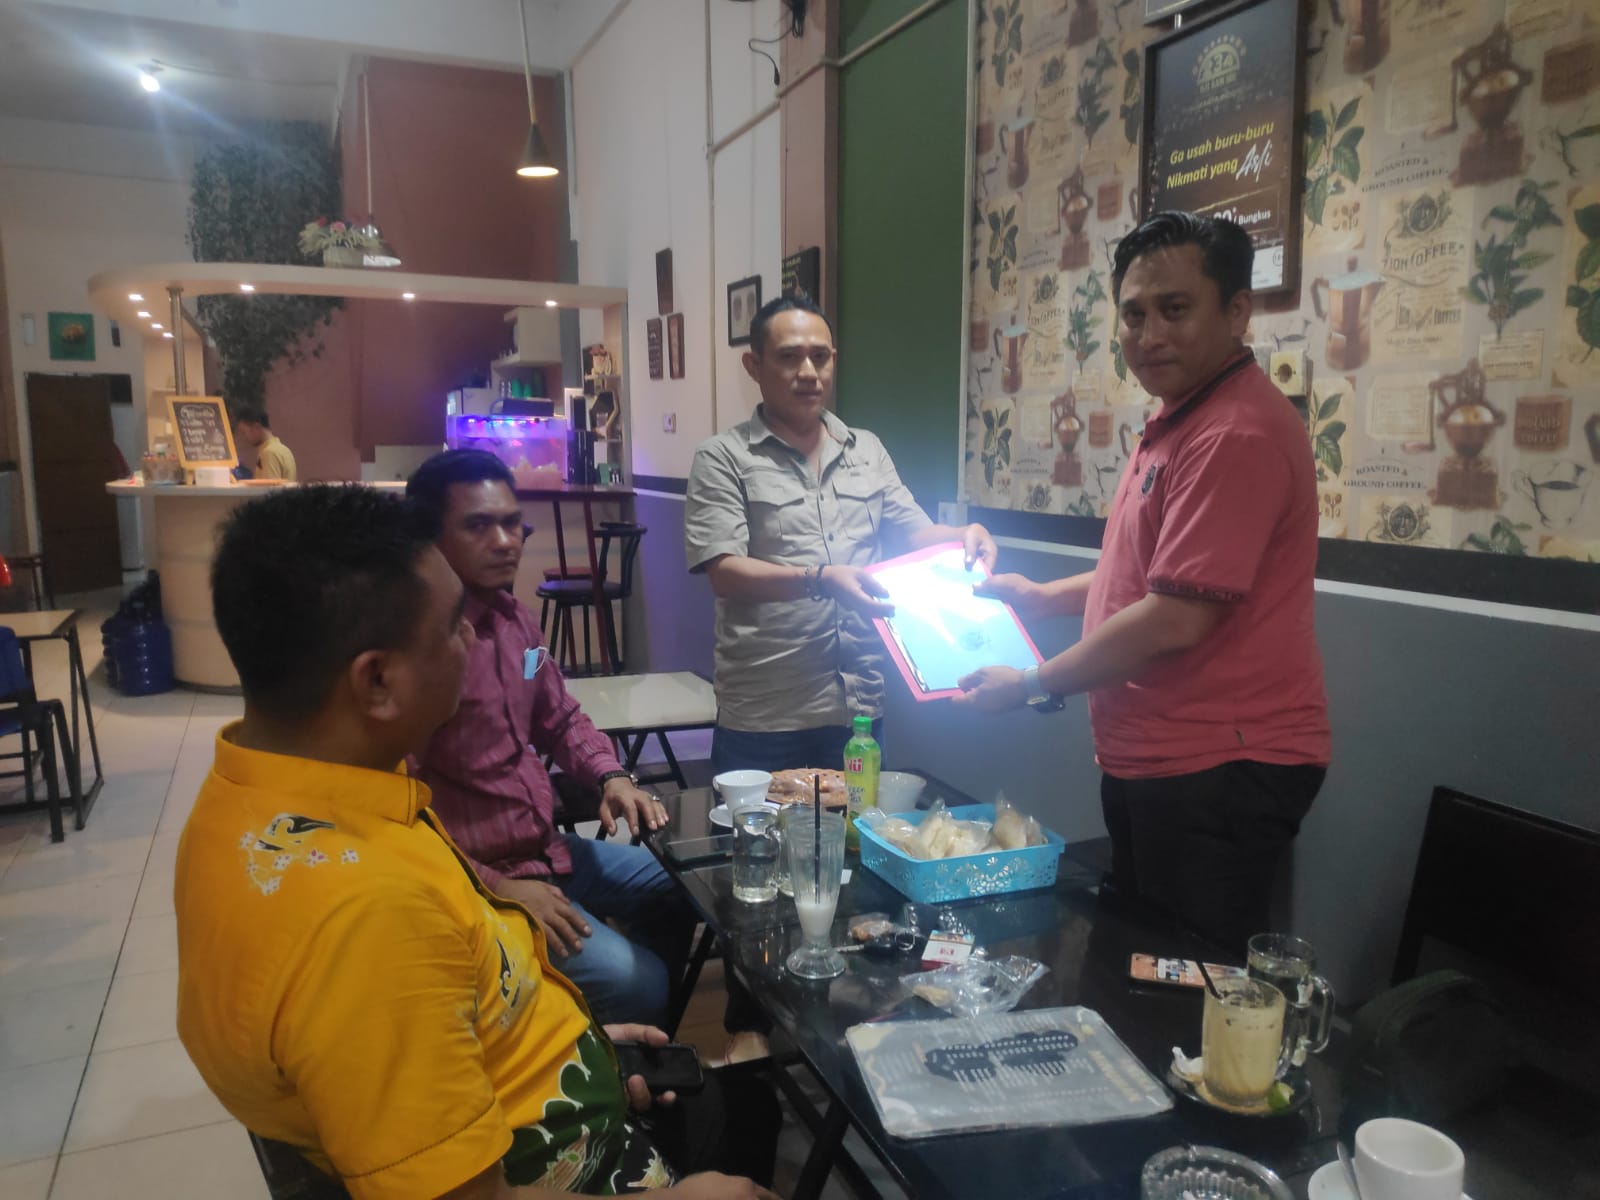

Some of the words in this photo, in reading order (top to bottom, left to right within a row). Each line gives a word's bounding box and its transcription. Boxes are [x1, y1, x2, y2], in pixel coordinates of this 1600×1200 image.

[1186, 139, 1212, 160] usah
[1214, 121, 1274, 151] buru-buru
[1166, 163, 1209, 190] Nikmati
[1209, 157, 1239, 180] yang
[1238, 208, 1271, 225] Bungkus
